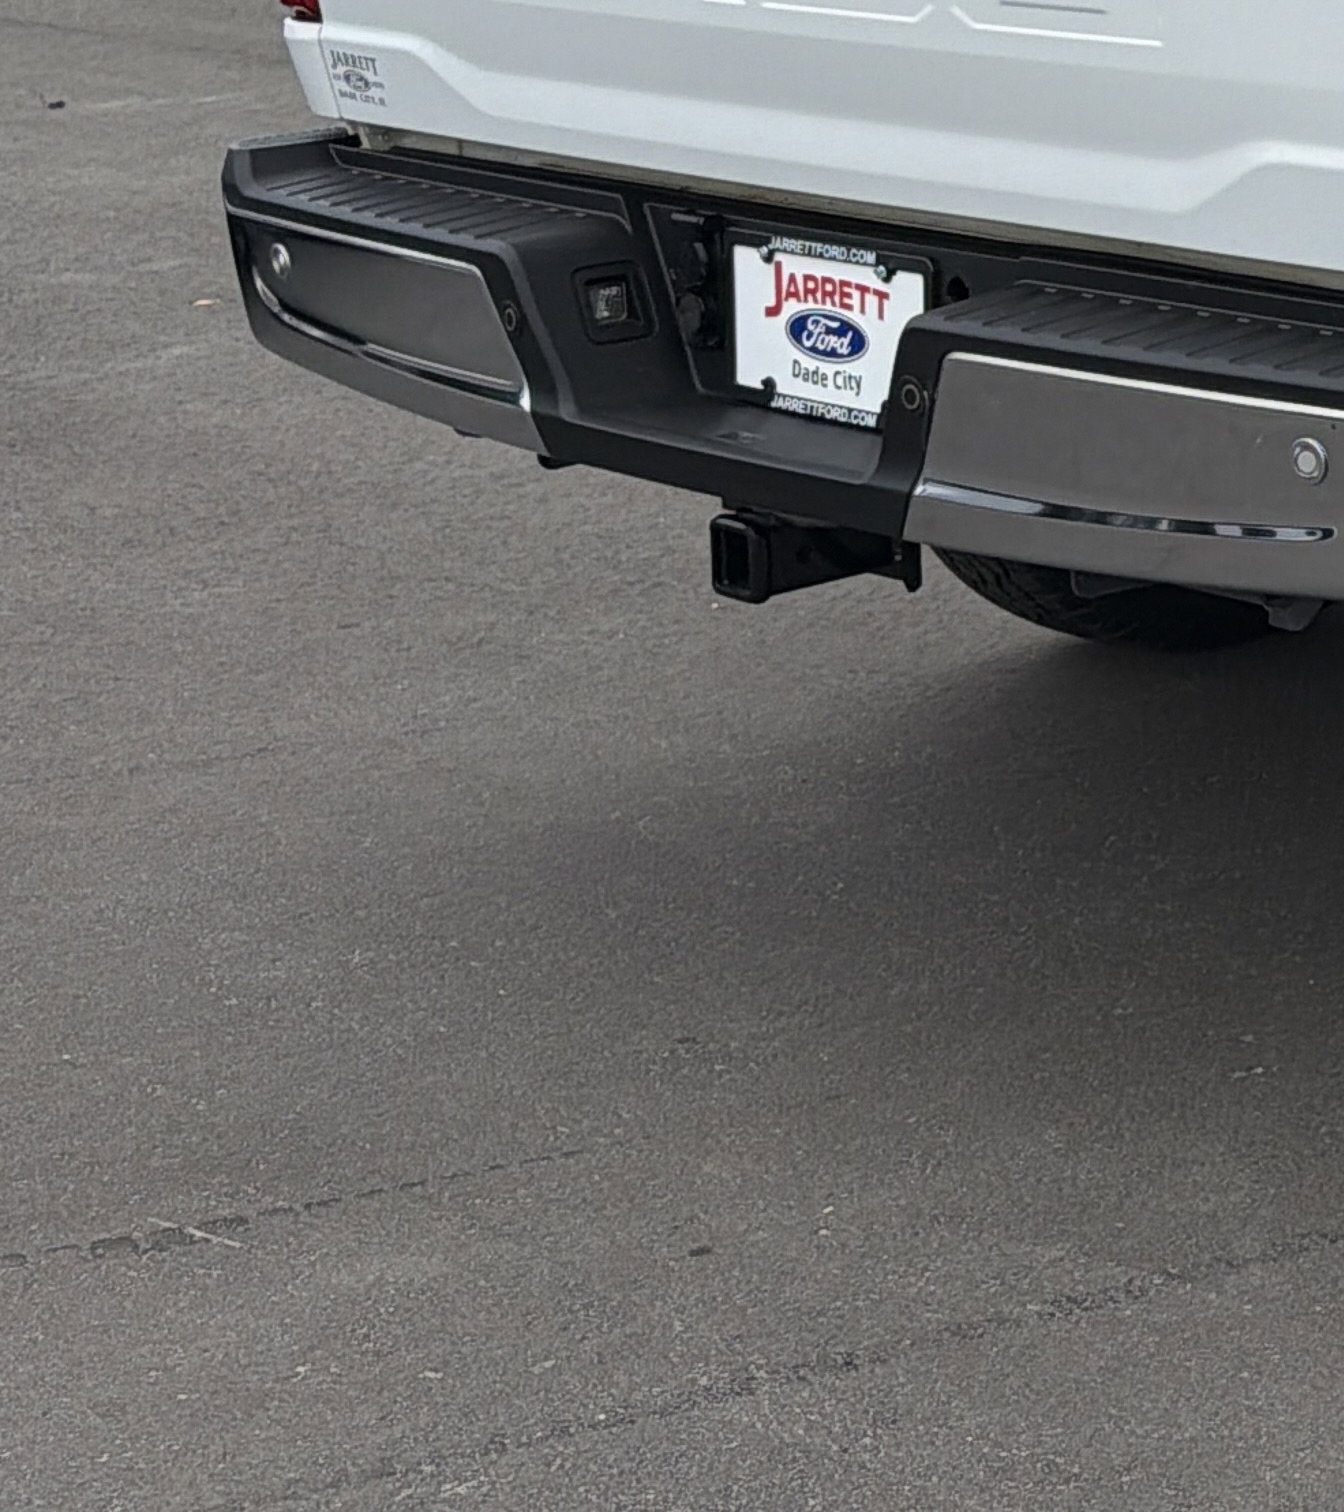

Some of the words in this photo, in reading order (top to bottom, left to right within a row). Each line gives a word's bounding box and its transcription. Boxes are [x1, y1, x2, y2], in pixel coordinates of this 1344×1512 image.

[767, 235, 877, 265] JARRETTFORD.COM
[764, 260, 891, 321] JARRETT
[801, 315, 853, 356] Ford
[792, 359, 829, 388] Dade
[832, 370, 863, 397] City
[769, 394, 878, 428] JARRETTFORD.COM
